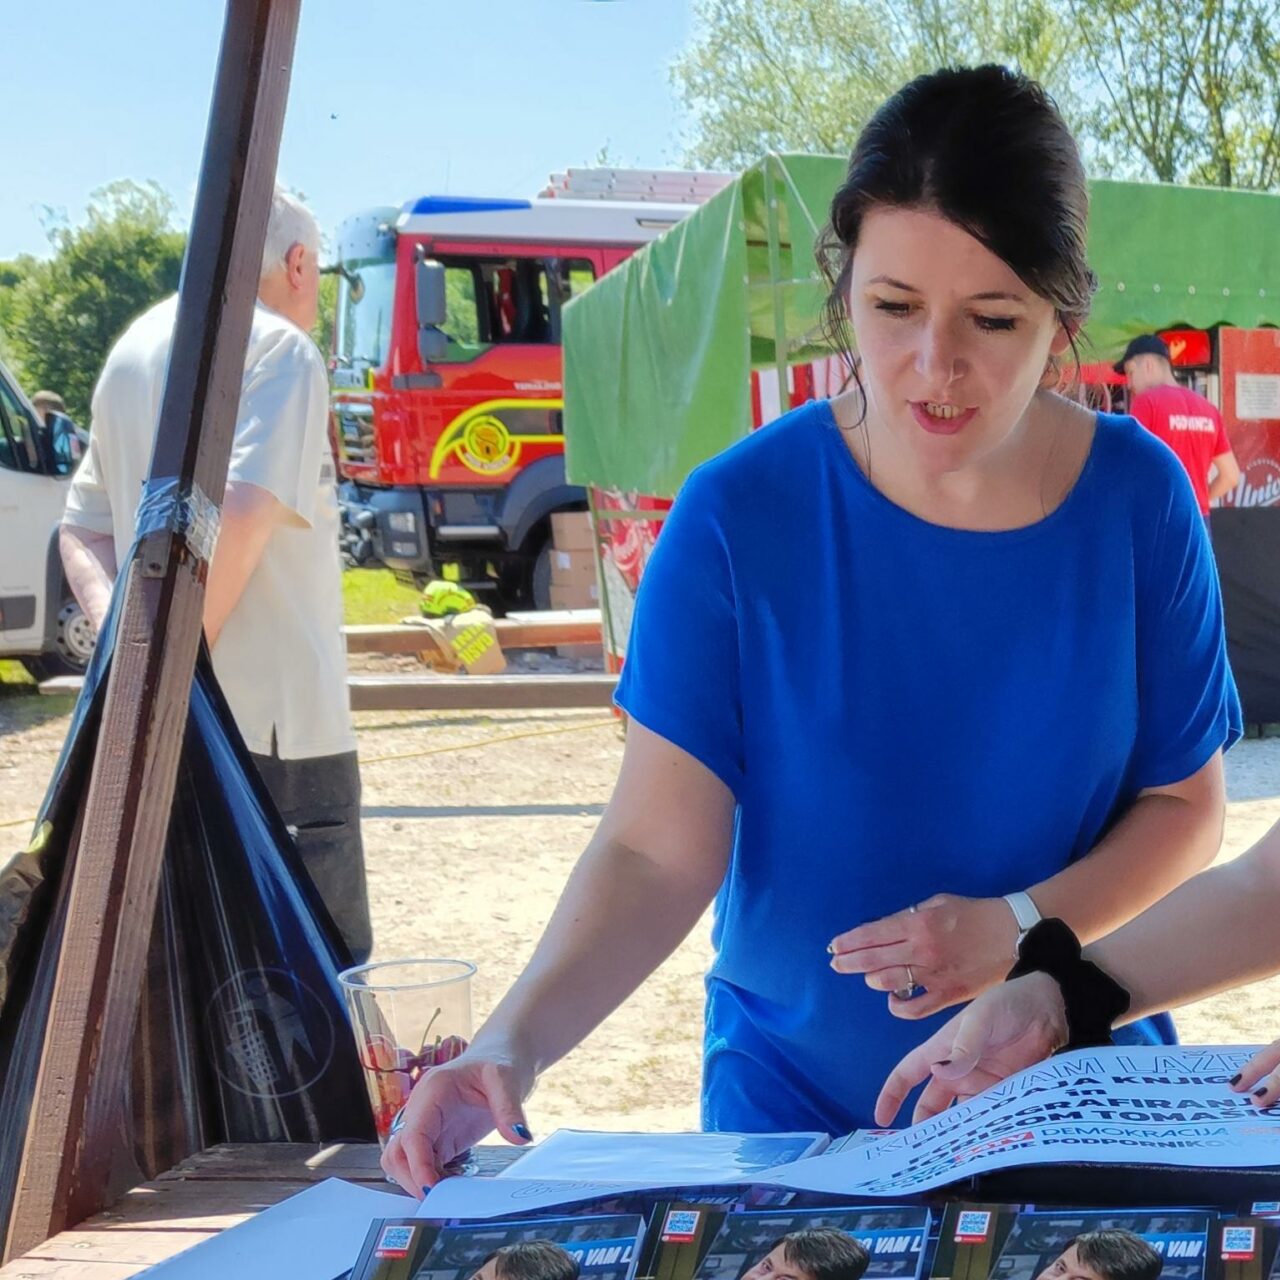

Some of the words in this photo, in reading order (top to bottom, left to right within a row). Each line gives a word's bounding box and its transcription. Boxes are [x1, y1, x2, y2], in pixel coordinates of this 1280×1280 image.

[984, 1056, 1106, 1101] VAM
[1116, 1050, 1257, 1075] LAŽE
[1112, 1075, 1233, 1086] KNJIG
[1065, 1088, 1107, 1097] in
[1041, 1126, 1230, 1139] DEMOKRACIJA
[874, 1235, 911, 1254] VAM
[1167, 1240, 1203, 1258] VAM
[584, 1246, 622, 1267] VAM
